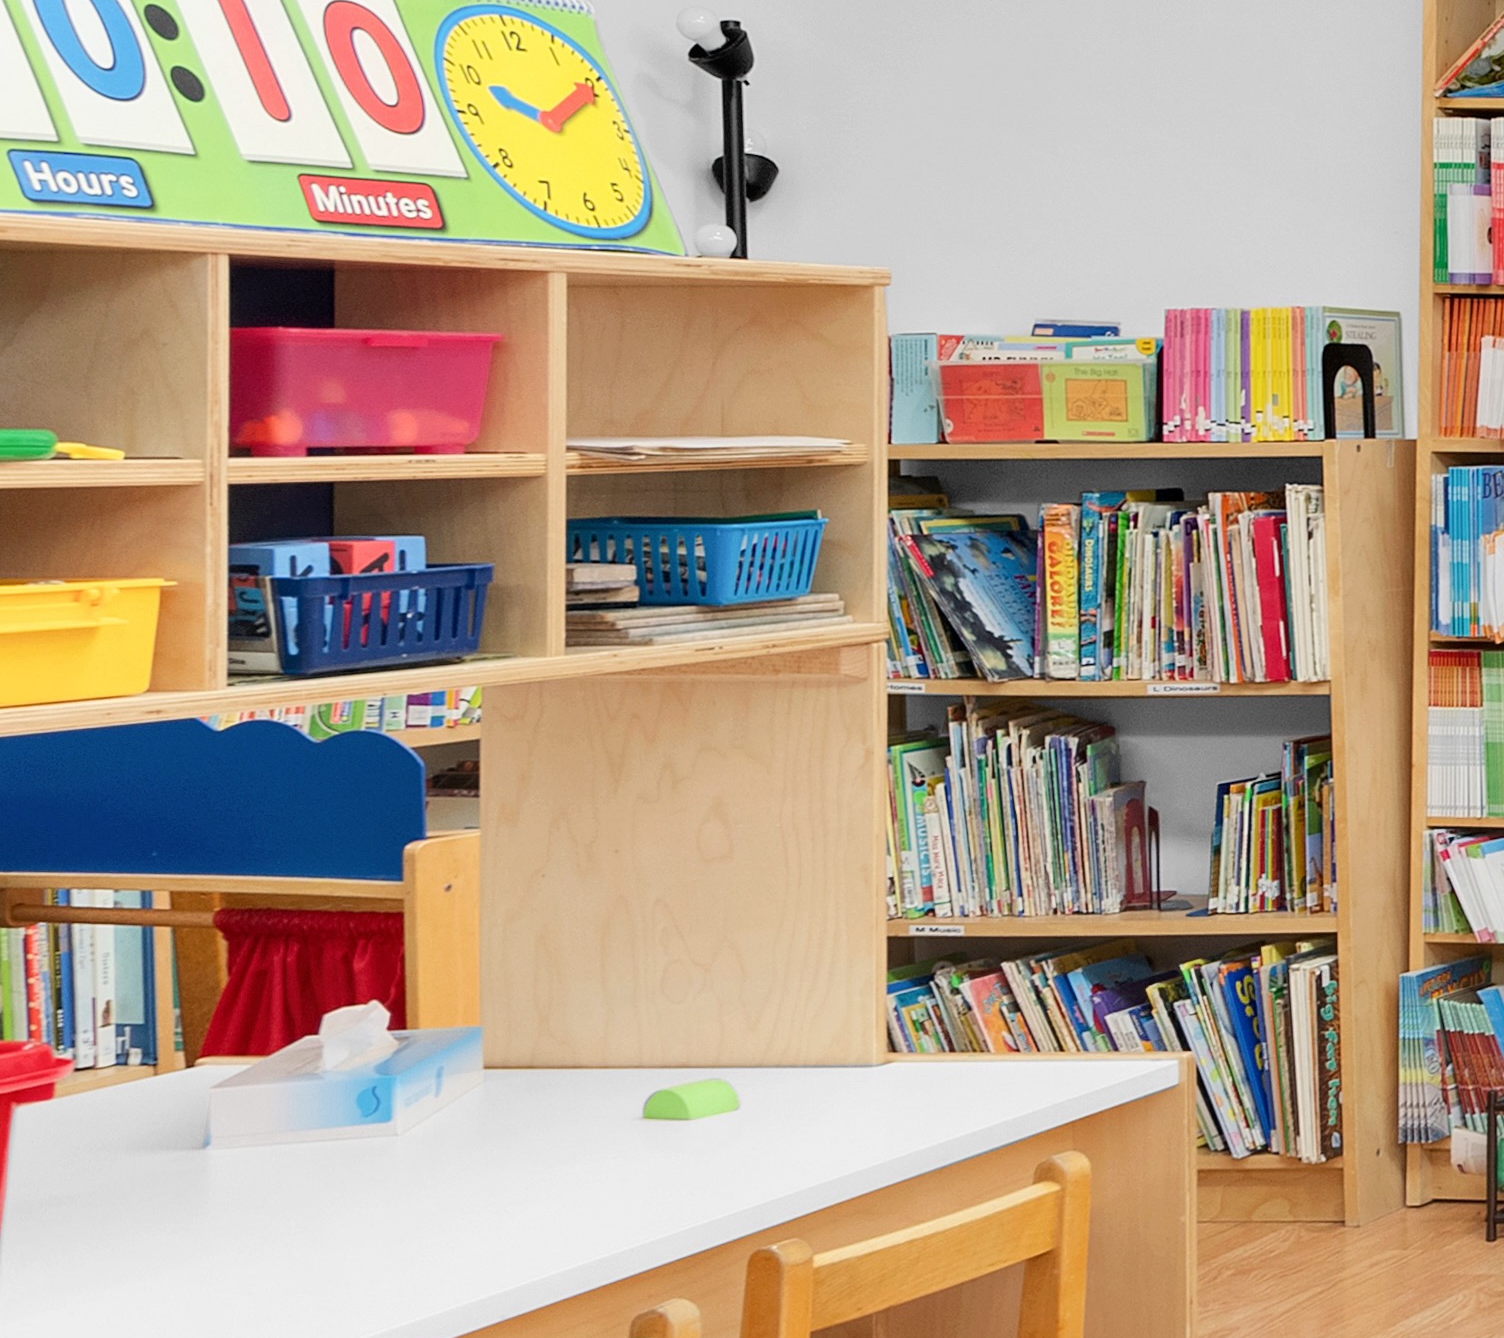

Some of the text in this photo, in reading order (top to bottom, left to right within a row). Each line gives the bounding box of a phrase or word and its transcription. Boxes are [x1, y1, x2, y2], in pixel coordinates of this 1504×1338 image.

[472, 39, 493, 61] 11
[501, 31, 527, 51] 12
[549, 47, 560, 66] 1
[459, 64, 481, 85] 10
[467, 104, 484, 125] 9
[612, 121, 625, 141] 3
[498, 148, 513, 169] 8
[618, 157, 632, 179] 4
[22, 161, 139, 200] Hours
[538, 180, 551, 200] 7
[310, 182, 433, 220] Minutes
[583, 192, 595, 211] 6
[610, 183, 624, 202] 5
[1345, 330, 1377, 340] STEALING
